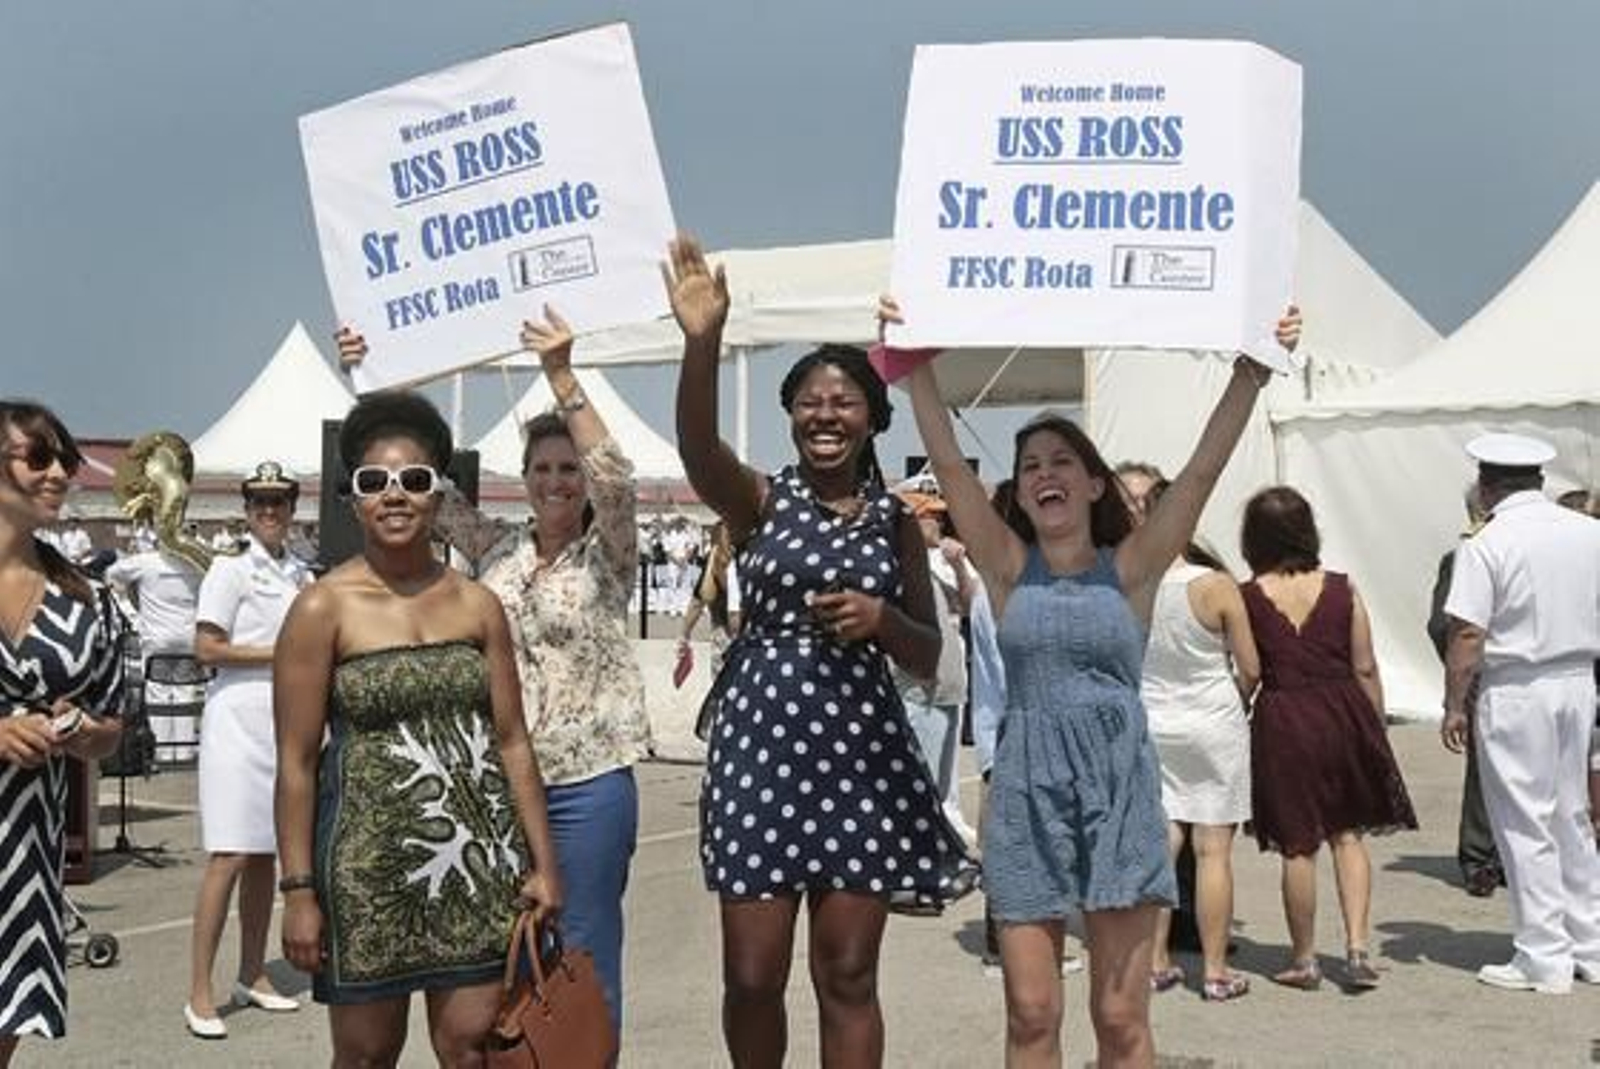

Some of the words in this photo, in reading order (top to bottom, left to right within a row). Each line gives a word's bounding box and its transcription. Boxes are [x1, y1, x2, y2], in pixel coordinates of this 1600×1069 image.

[1020, 83, 1106, 104] Welcome
[1109, 82, 1166, 102] Home
[399, 113, 468, 144] Welcome
[470, 97, 516, 123] Home
[997, 117, 1064, 158] USS
[1077, 115, 1183, 158] ROSS
[390, 149, 447, 200] USS
[453, 121, 543, 183] ROSS
[361, 229, 413, 280] Sr.
[420, 180, 602, 262] Clemente
[938, 180, 995, 230] Sr.
[1012, 183, 1235, 232] Clemente
[946, 255, 1014, 289] FFSC
[1023, 258, 1094, 289] Rota
[386, 287, 441, 332] FFSC
[444, 275, 501, 316] Rota
